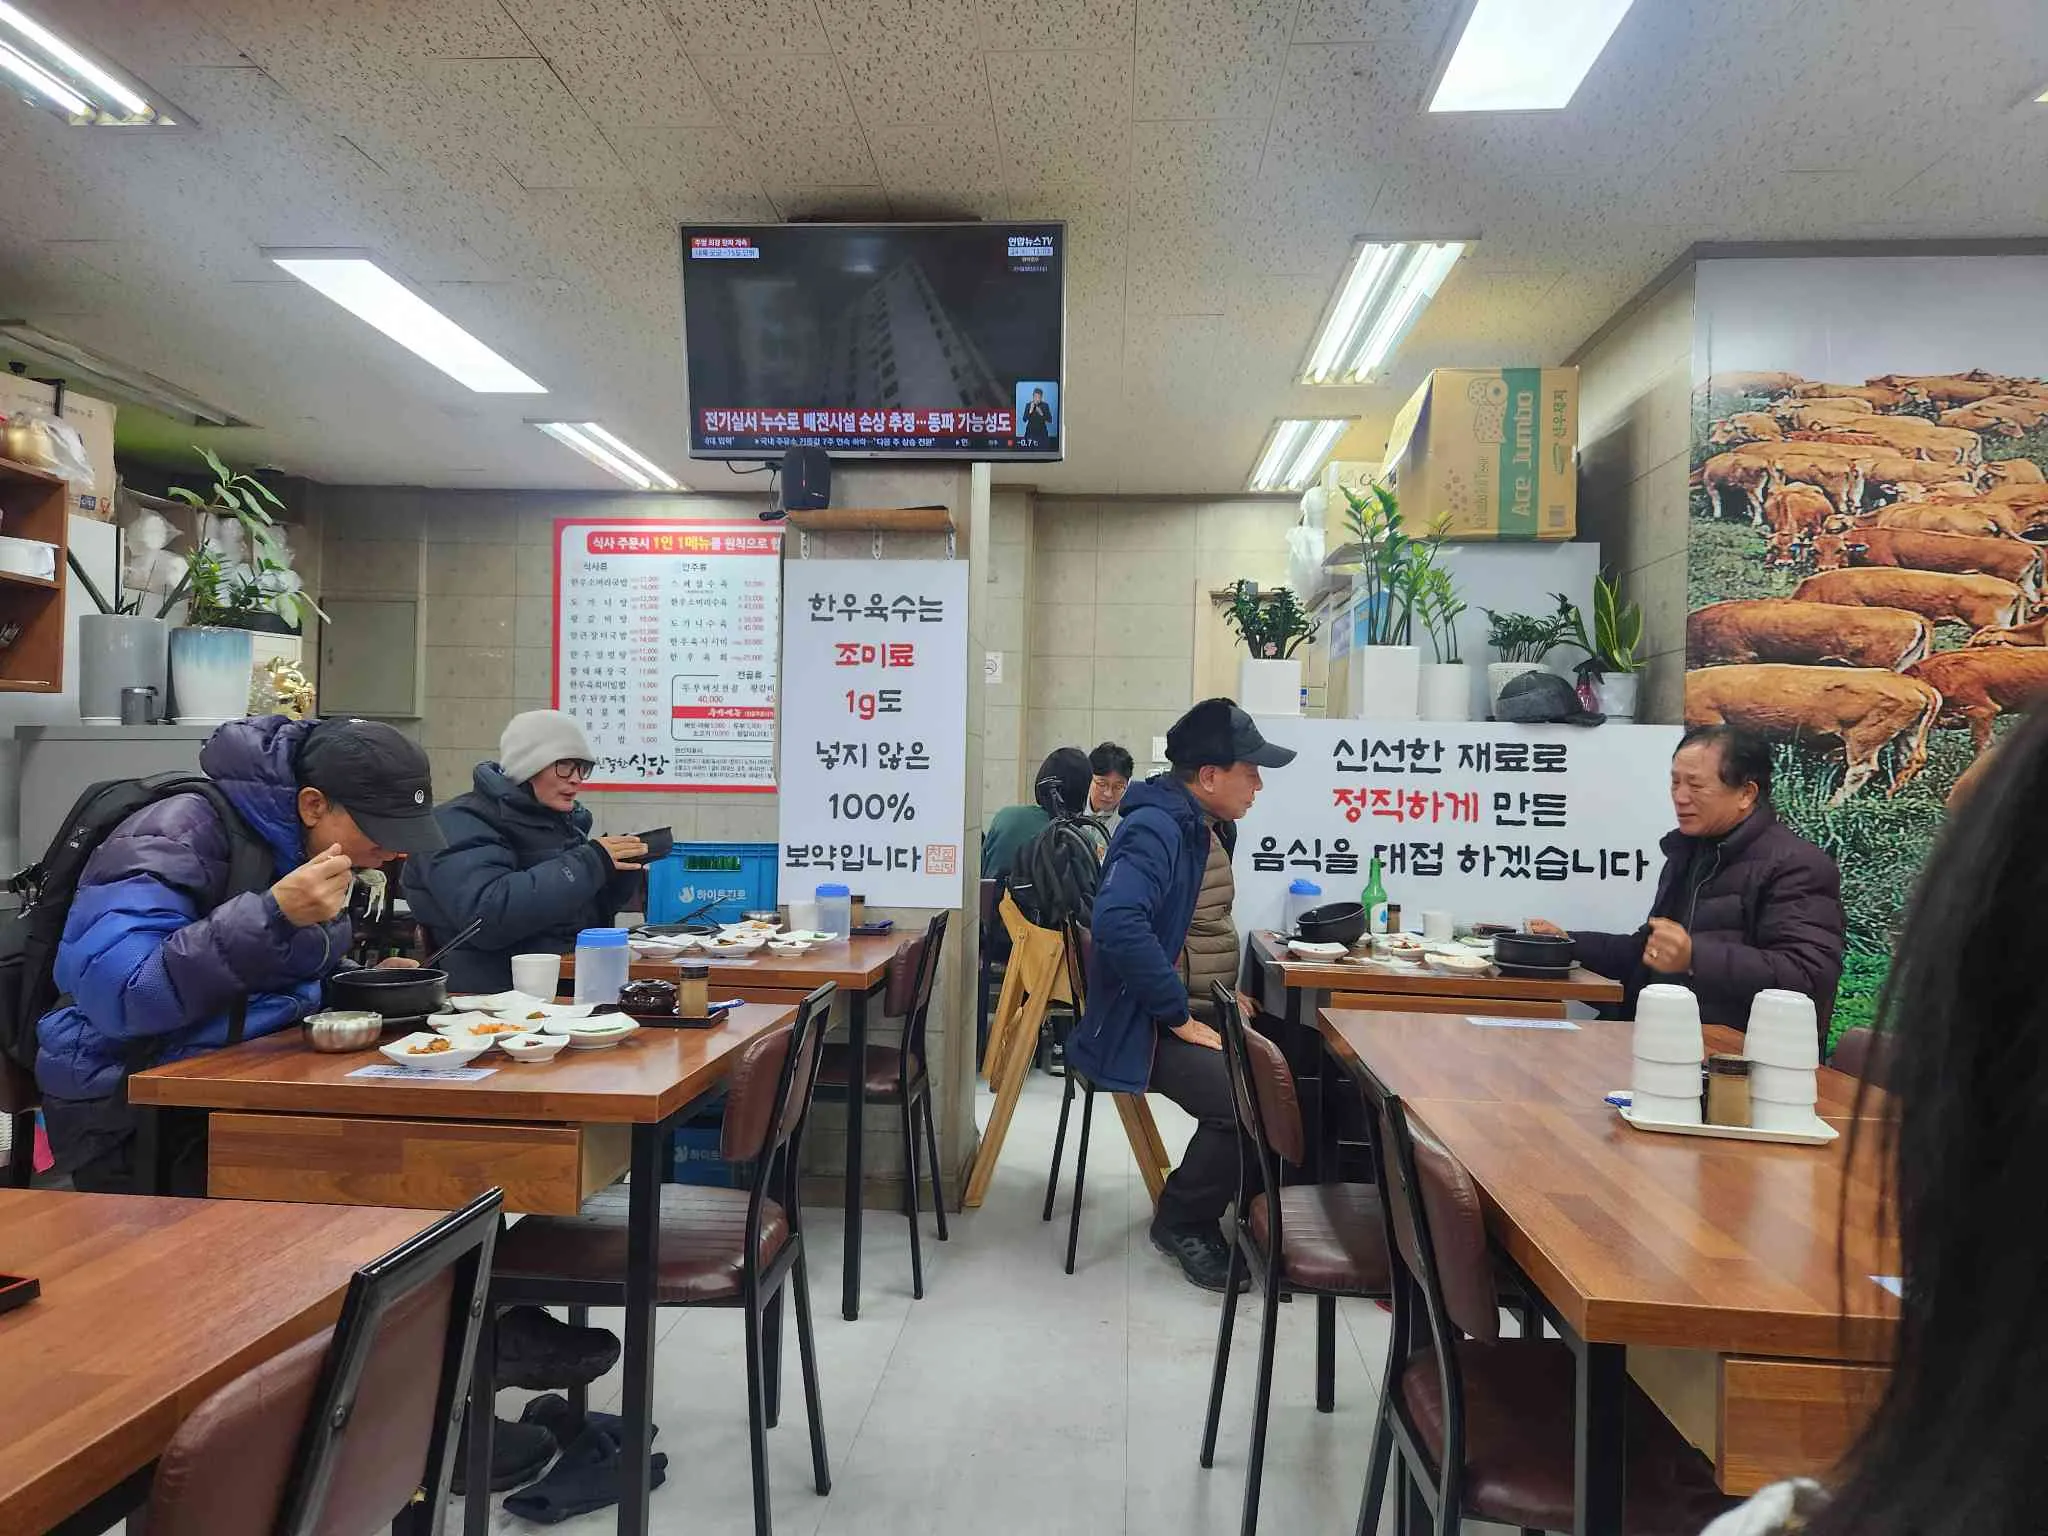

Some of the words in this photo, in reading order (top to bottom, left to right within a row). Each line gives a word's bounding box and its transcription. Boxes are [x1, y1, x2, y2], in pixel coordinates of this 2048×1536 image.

[1008, 237, 1054, 247] 연합뉴스TV
[704, 411, 757, 432] 전기실서
[760, 411, 801, 431] 누수로
[803, 411, 856, 433] 배전시설
[858, 412, 885, 432] 손상
[958, 411, 1012, 433] 가능성도
[1513, 390, 1534, 470] Jumbo
[1512, 476, 1532, 517] Ace
[592, 536, 615, 550] 식사
[617, 536, 650, 550] 주문시
[652, 535, 673, 550] 1인
[677, 535, 721, 551] 1메뉴를
[584, 561, 608, 572] 식사류
[682, 562, 708, 572] 안주류
[807, 593, 944, 623] 한우육수는
[834, 642, 915, 669] 조미료
[697, 695, 724, 704] 40,000
[845, 689, 903, 721] 1g도
[816, 741, 868, 770] 넣지
[877, 741, 931, 770] 않은
[1332, 738, 1446, 774] 신선한
[1457, 742, 1569, 773] 재료로
[828, 792, 916, 824] 100%
[1333, 787, 1480, 824] 정직하게
[1493, 791, 1568, 827] 만든
[785, 844, 923, 873] 보약입니다
[1252, 836, 1360, 876] 음식을
[1374, 841, 1445, 878] 대접
[1457, 843, 1650, 882] 하겠습니다
[696, 888, 748, 902] 하이트진로
